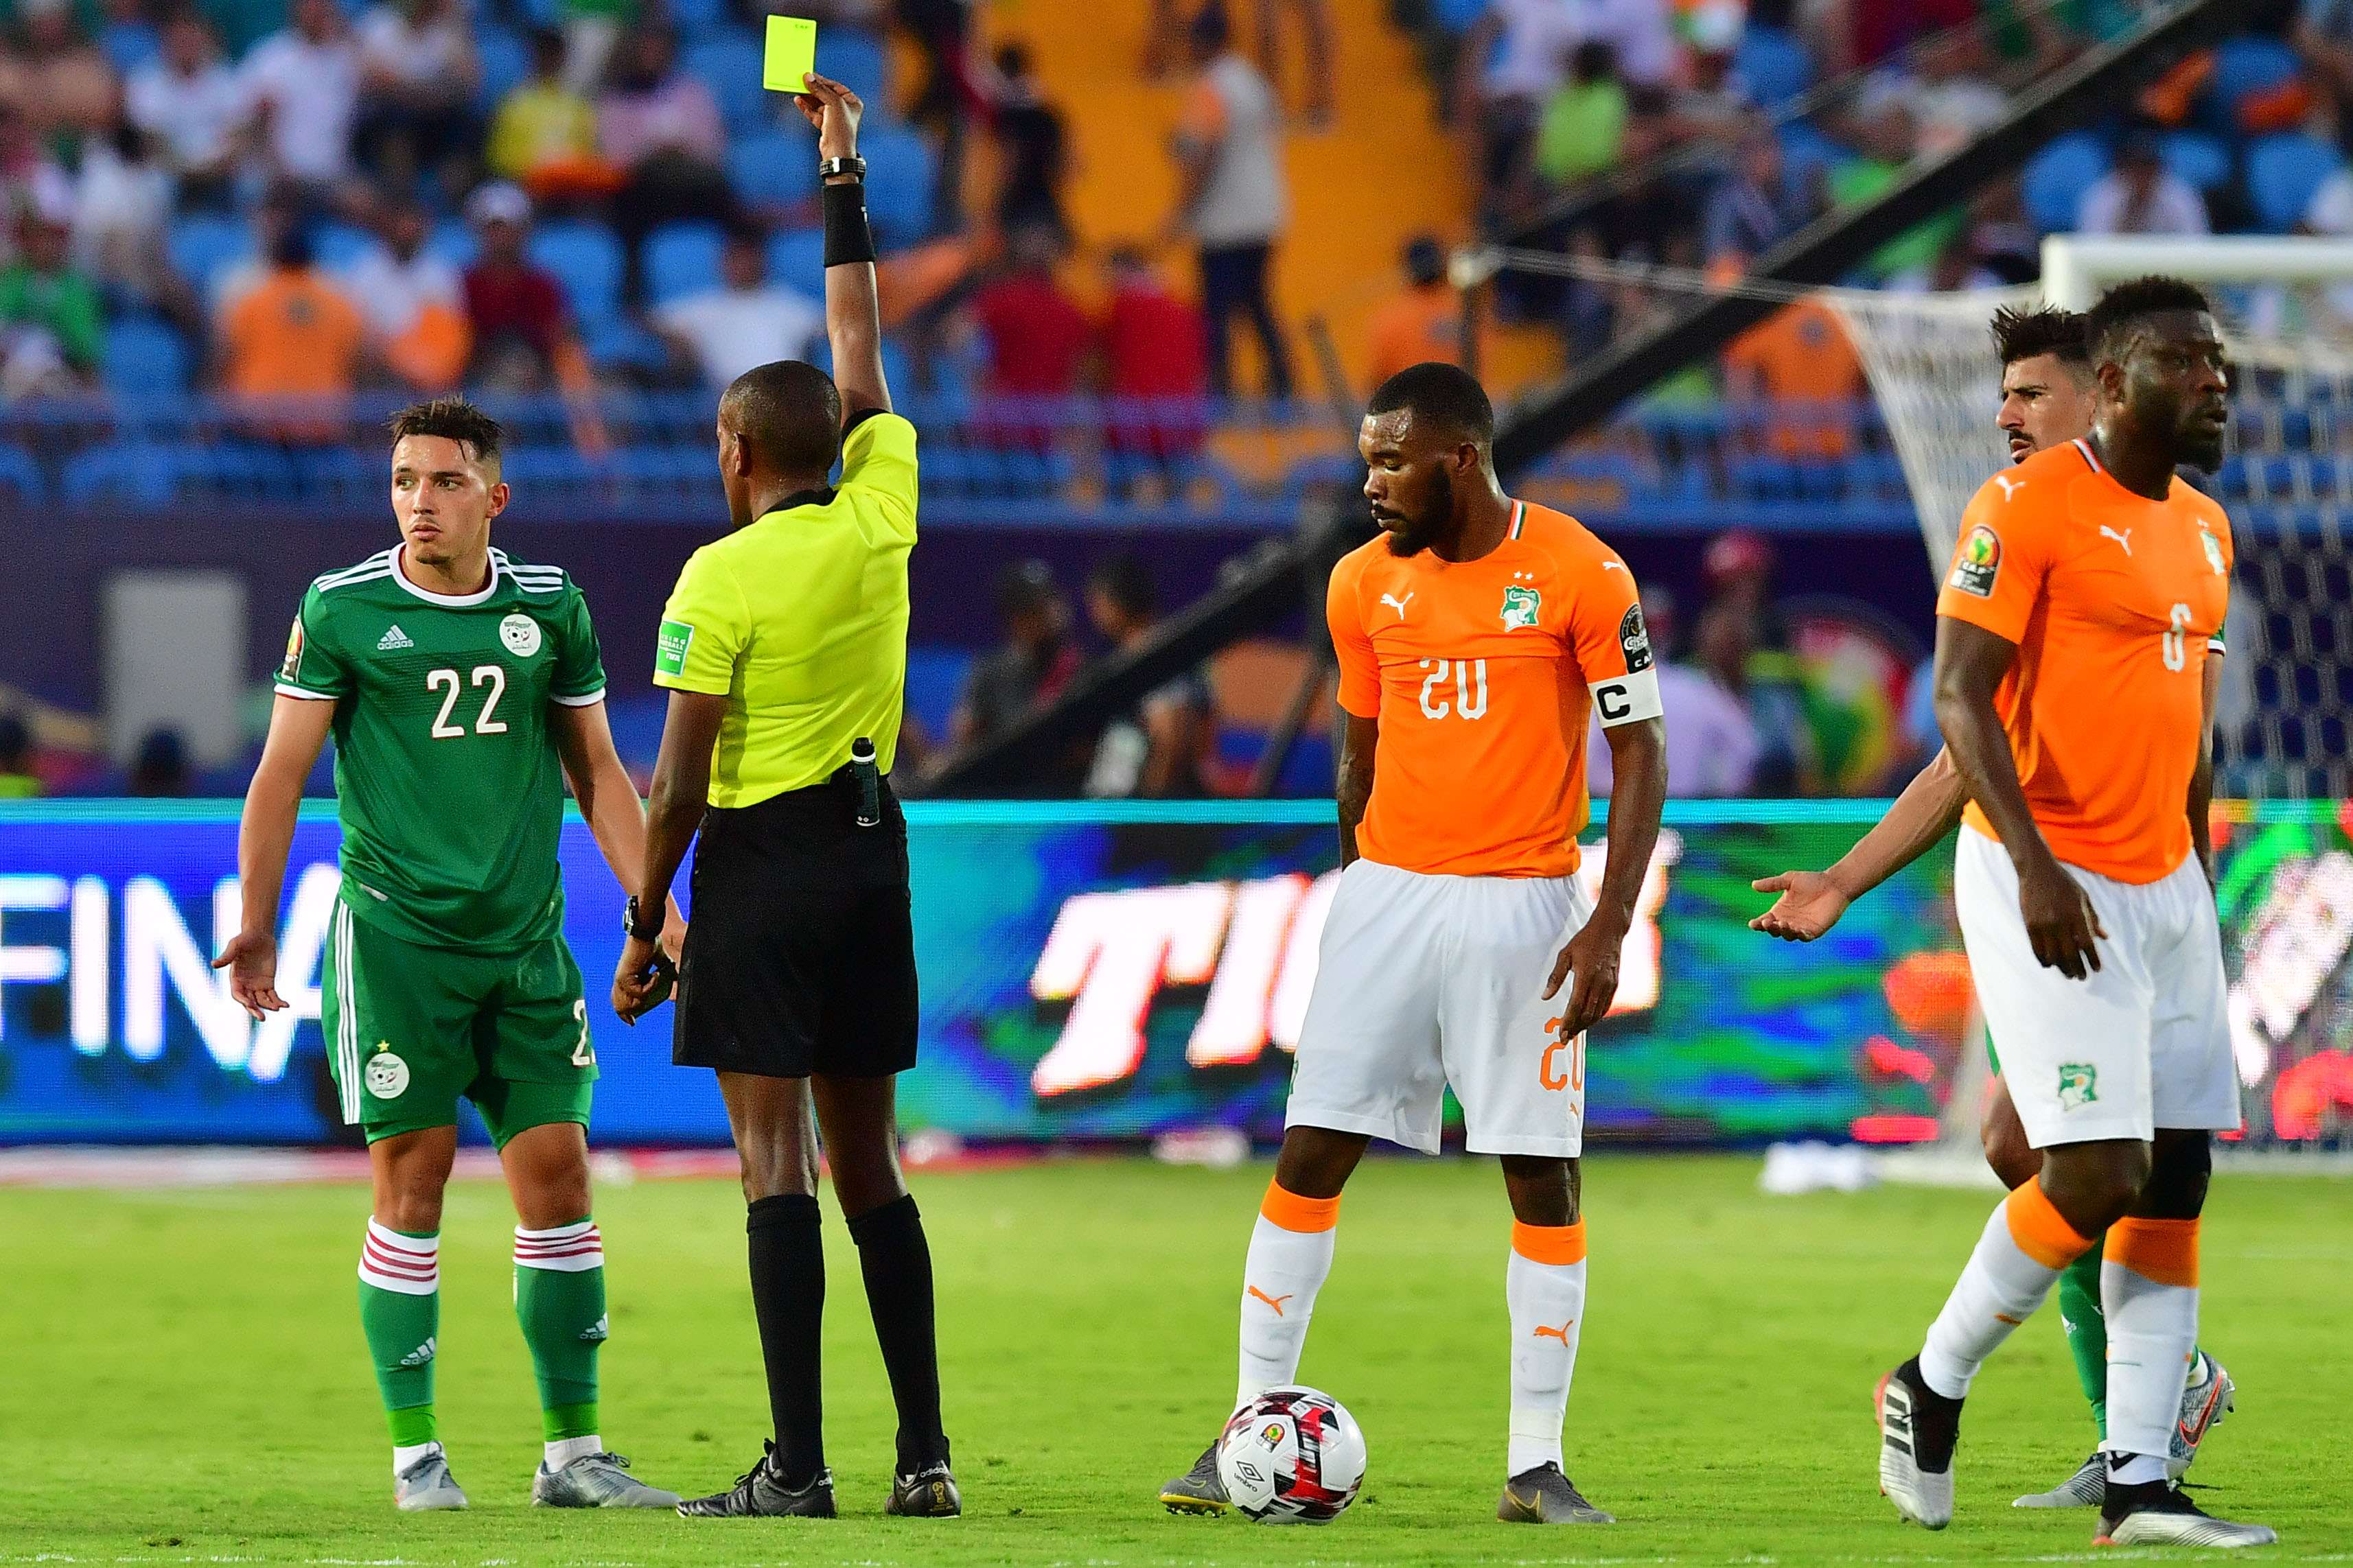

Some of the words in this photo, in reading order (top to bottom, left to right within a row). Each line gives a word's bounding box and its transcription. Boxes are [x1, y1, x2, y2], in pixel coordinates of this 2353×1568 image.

[377, 639, 415, 650] adidas
[2163, 603, 2192, 672] 6
[427, 665, 508, 738] 22
[1419, 657, 1487, 720] 20
[1597, 684, 1631, 721] C
[1233, 1473, 1257, 1493] umbro
